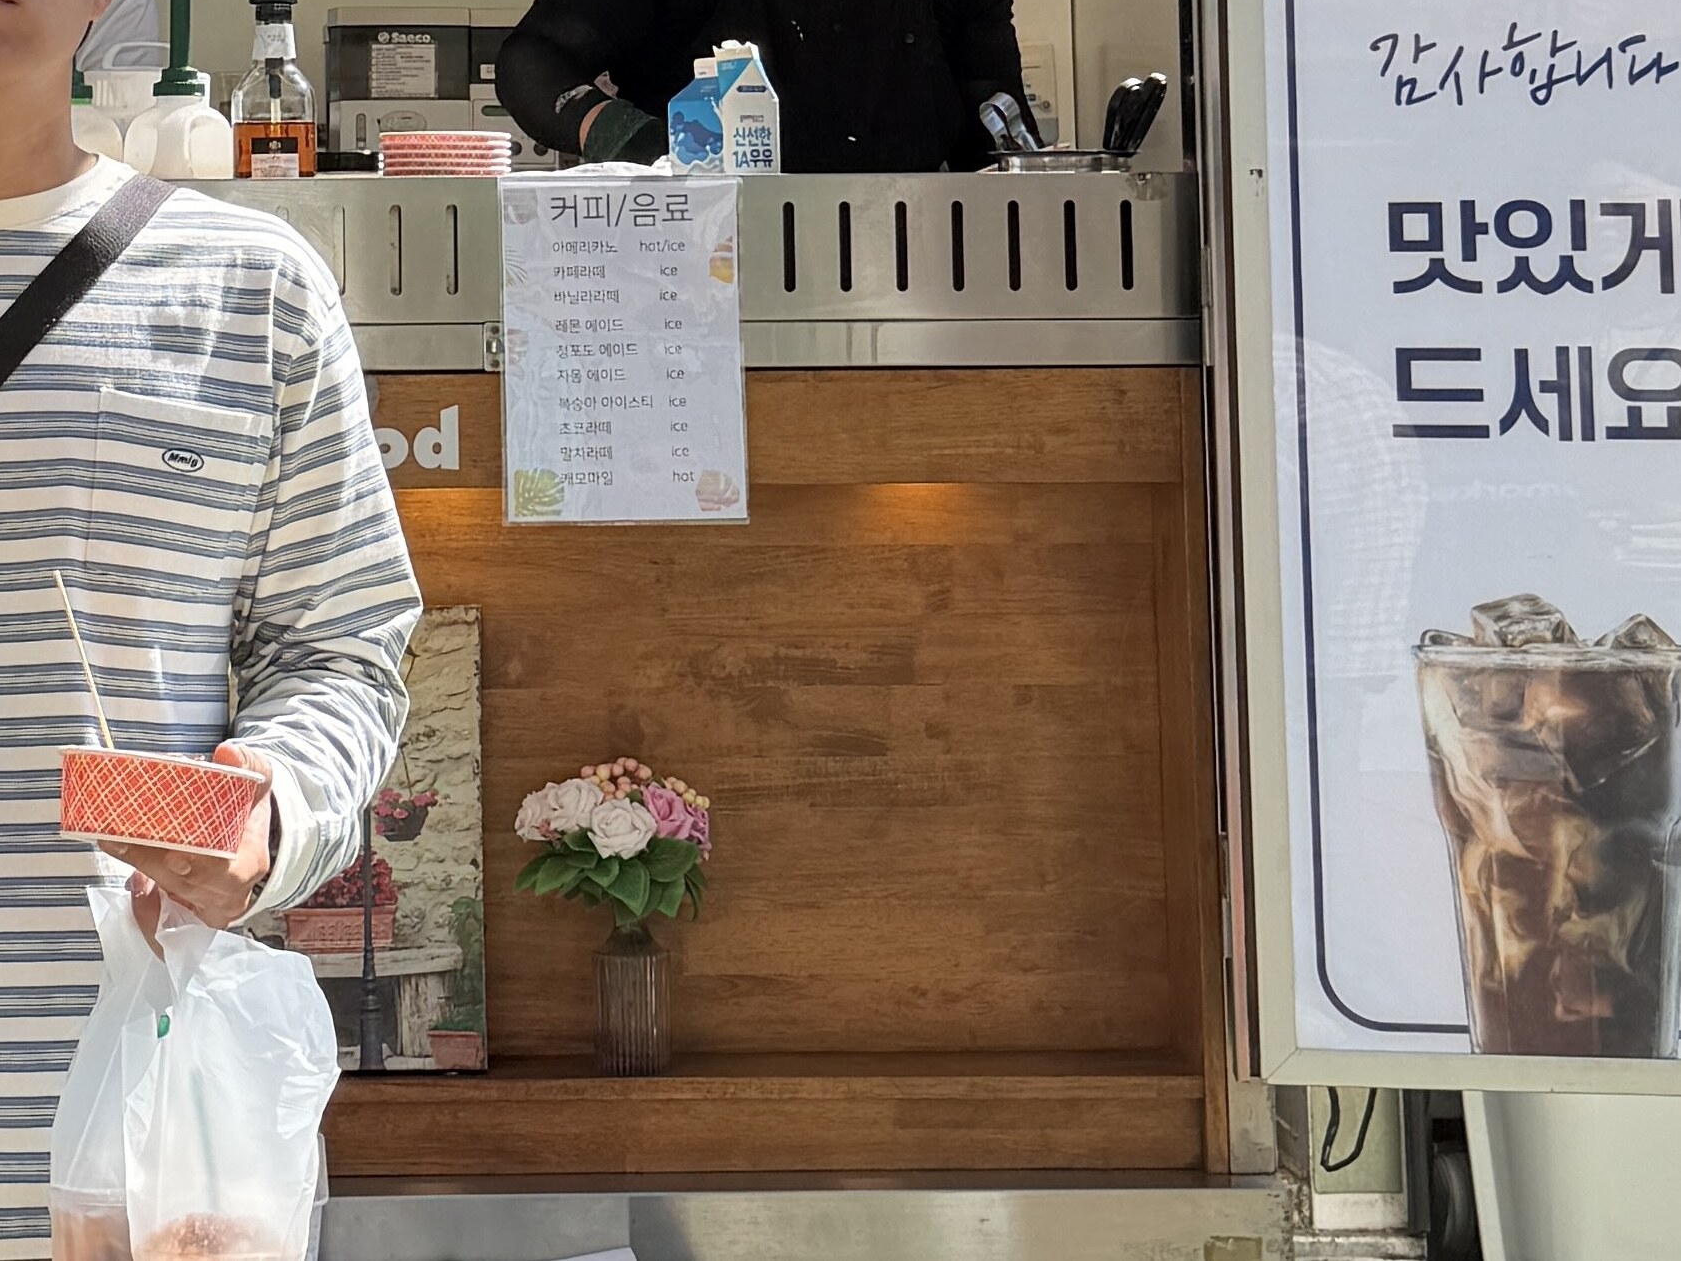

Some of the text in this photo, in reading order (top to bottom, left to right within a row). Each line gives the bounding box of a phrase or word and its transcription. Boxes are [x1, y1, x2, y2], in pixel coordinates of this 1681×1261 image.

[390, 31, 432, 44] Saeco
[1369, 21, 1681, 107] 감사합니다
[733, 126, 773, 147] 신선한
[732, 149, 774, 168] 1A우유
[550, 193, 693, 228] 커피/음료
[552, 239, 686, 254] 아메리카노 hot/ice
[553, 265, 678, 279] 카페라떼 ice
[554, 289, 678, 304] 바닐라라떼 ice
[555, 318, 682, 334] 레몬 에이드 ice
[555, 342, 682, 359] 청포도 에이드 ice
[557, 368, 685, 384] 자몽 에이드 ice
[1391, 345, 1681, 442] 드세요
[559, 394, 687, 412] 복숭아 아이스티 ice
[559, 421, 688, 435] 초코라떼 ice
[560, 446, 690, 461] 말차라떼 ice
[560, 471, 695, 486] 캐모마일 hot
